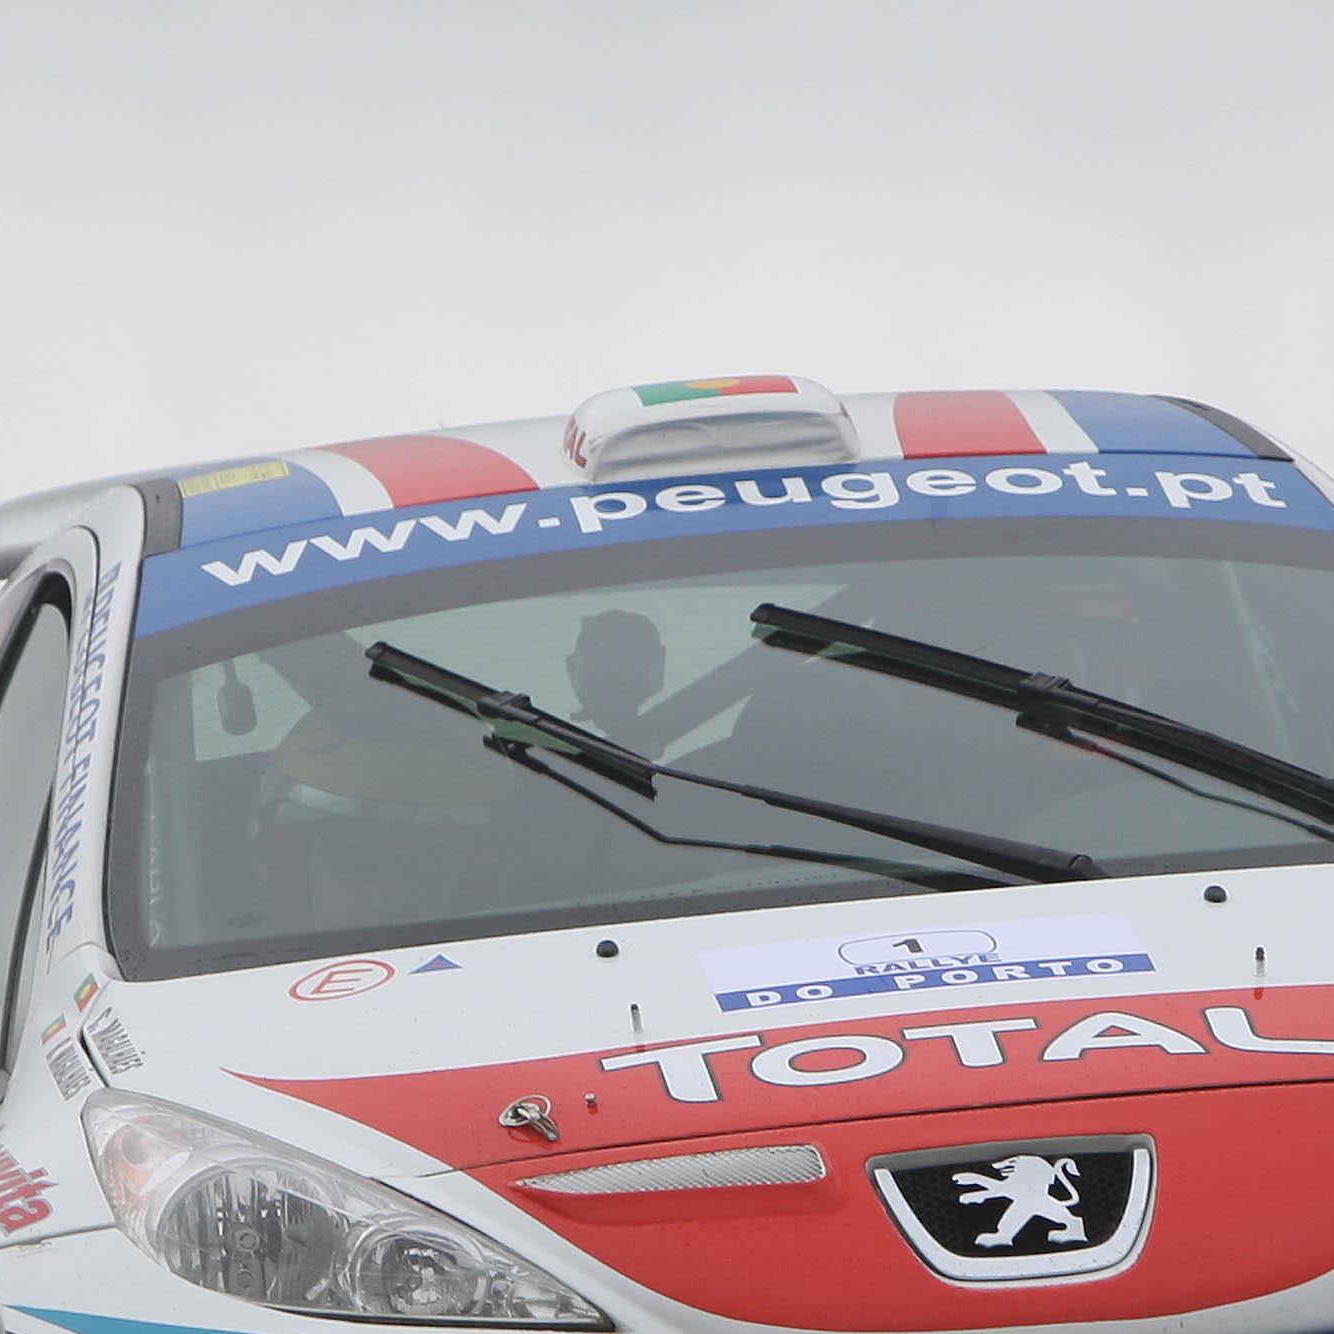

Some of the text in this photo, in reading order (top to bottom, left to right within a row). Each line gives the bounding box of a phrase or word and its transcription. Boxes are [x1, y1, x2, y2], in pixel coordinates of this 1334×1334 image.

[200, 461, 1287, 587] www.peugeot.pt
[853, 952, 1003, 976] RALLYE
[892, 938, 923, 954] 1
[746, 958, 1124, 1007] DO PORTO
